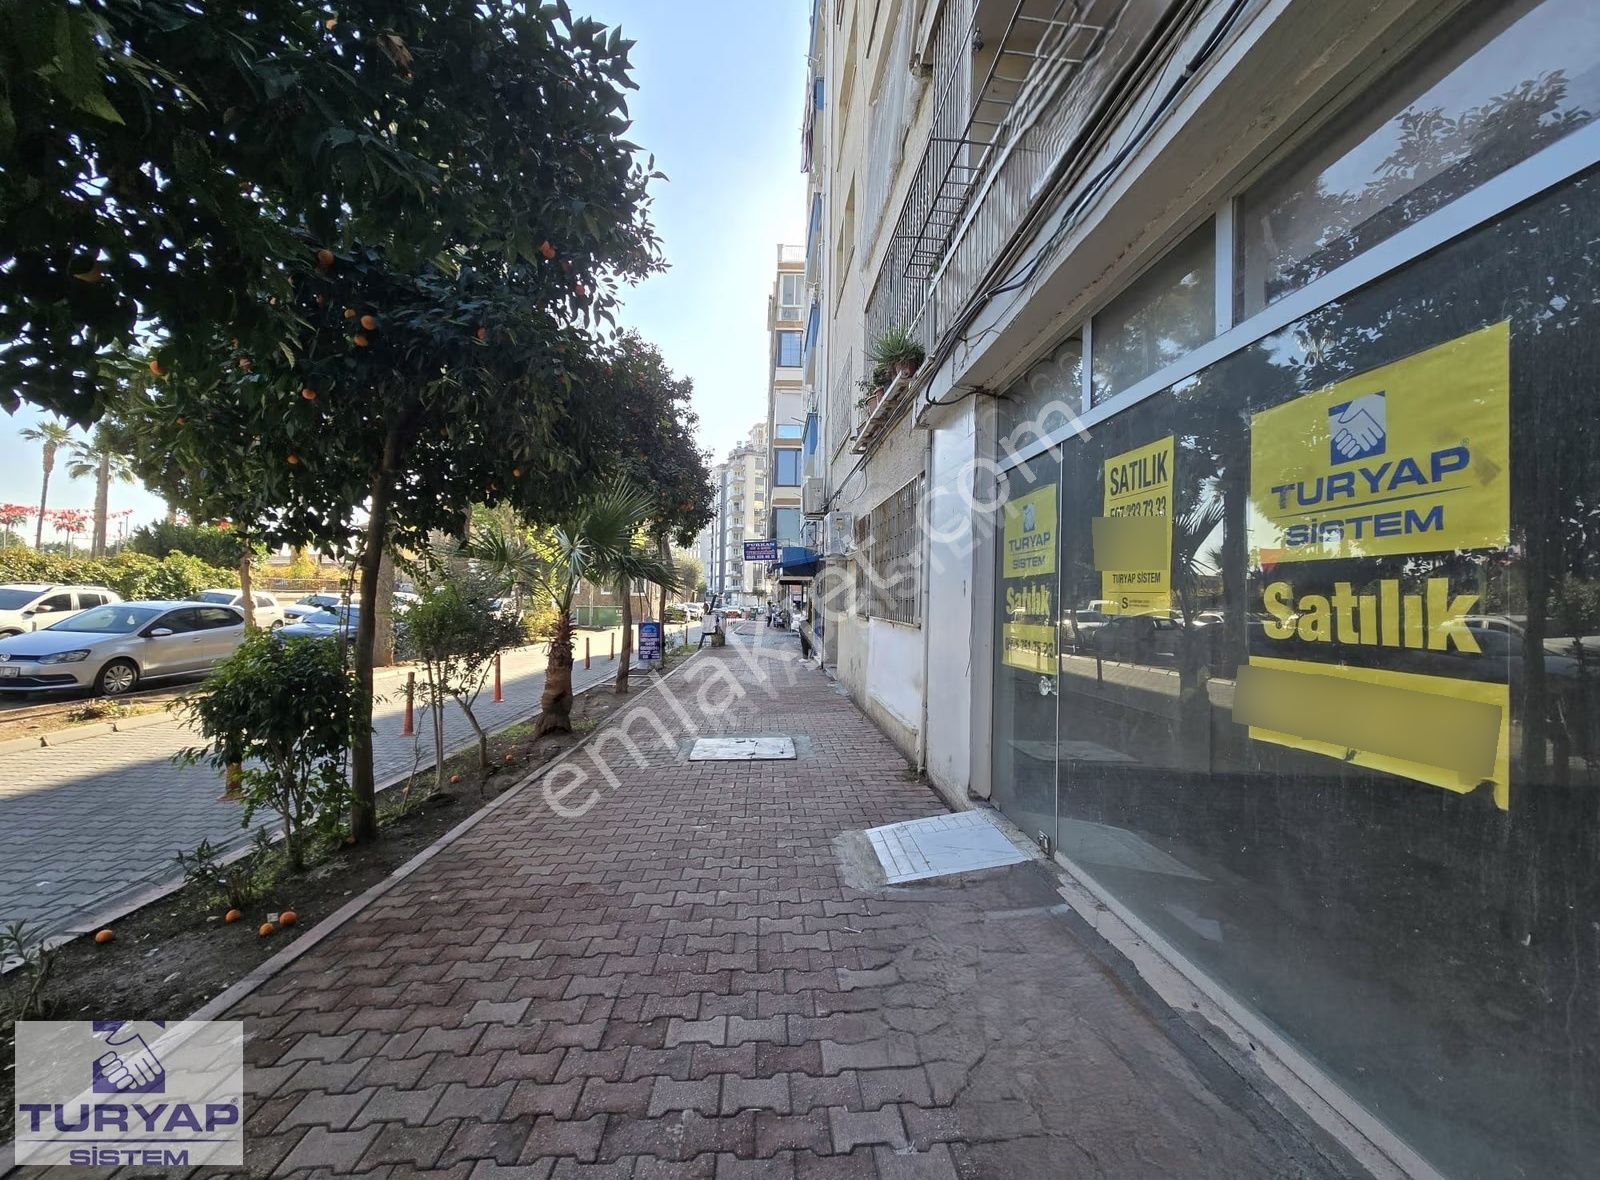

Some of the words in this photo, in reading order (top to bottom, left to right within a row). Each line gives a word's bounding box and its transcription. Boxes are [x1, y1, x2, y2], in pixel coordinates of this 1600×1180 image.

[1110, 450, 1168, 496] SATILIK
[1271, 446, 1470, 509] TURYAP
[1009, 532, 1050, 554] TURYAP
[1285, 504, 1443, 547] SİSTEM
[1112, 573, 1136, 584] TURYAP
[1137, 571, 1161, 584] SİSTEM
[1262, 577, 1482, 653] Satılık
